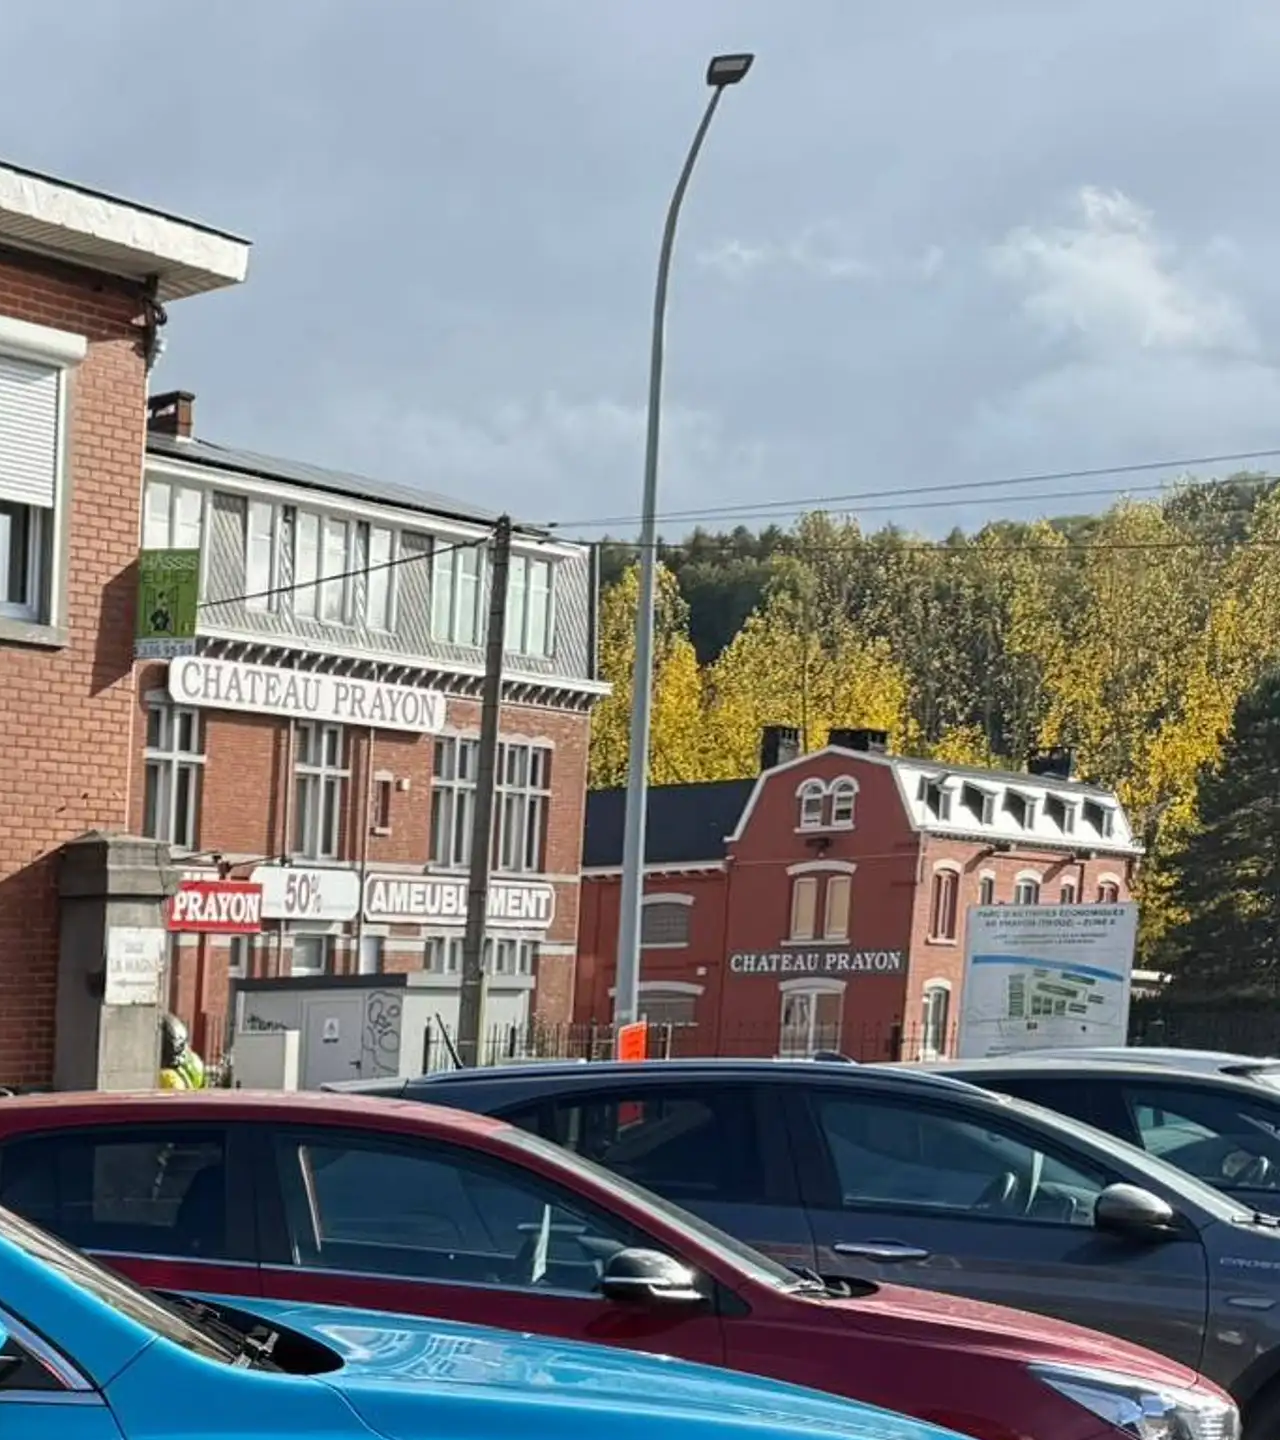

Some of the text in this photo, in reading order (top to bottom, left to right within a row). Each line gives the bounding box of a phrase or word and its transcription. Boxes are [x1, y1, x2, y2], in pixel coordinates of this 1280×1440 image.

[181, 661, 439, 727] CHATEAU PRAYON
[172, 891, 261, 924] PRAYON
[370, 881, 550, 918] AMEUBLMENT
[730, 951, 901, 972] CHATEAU PRAYON
